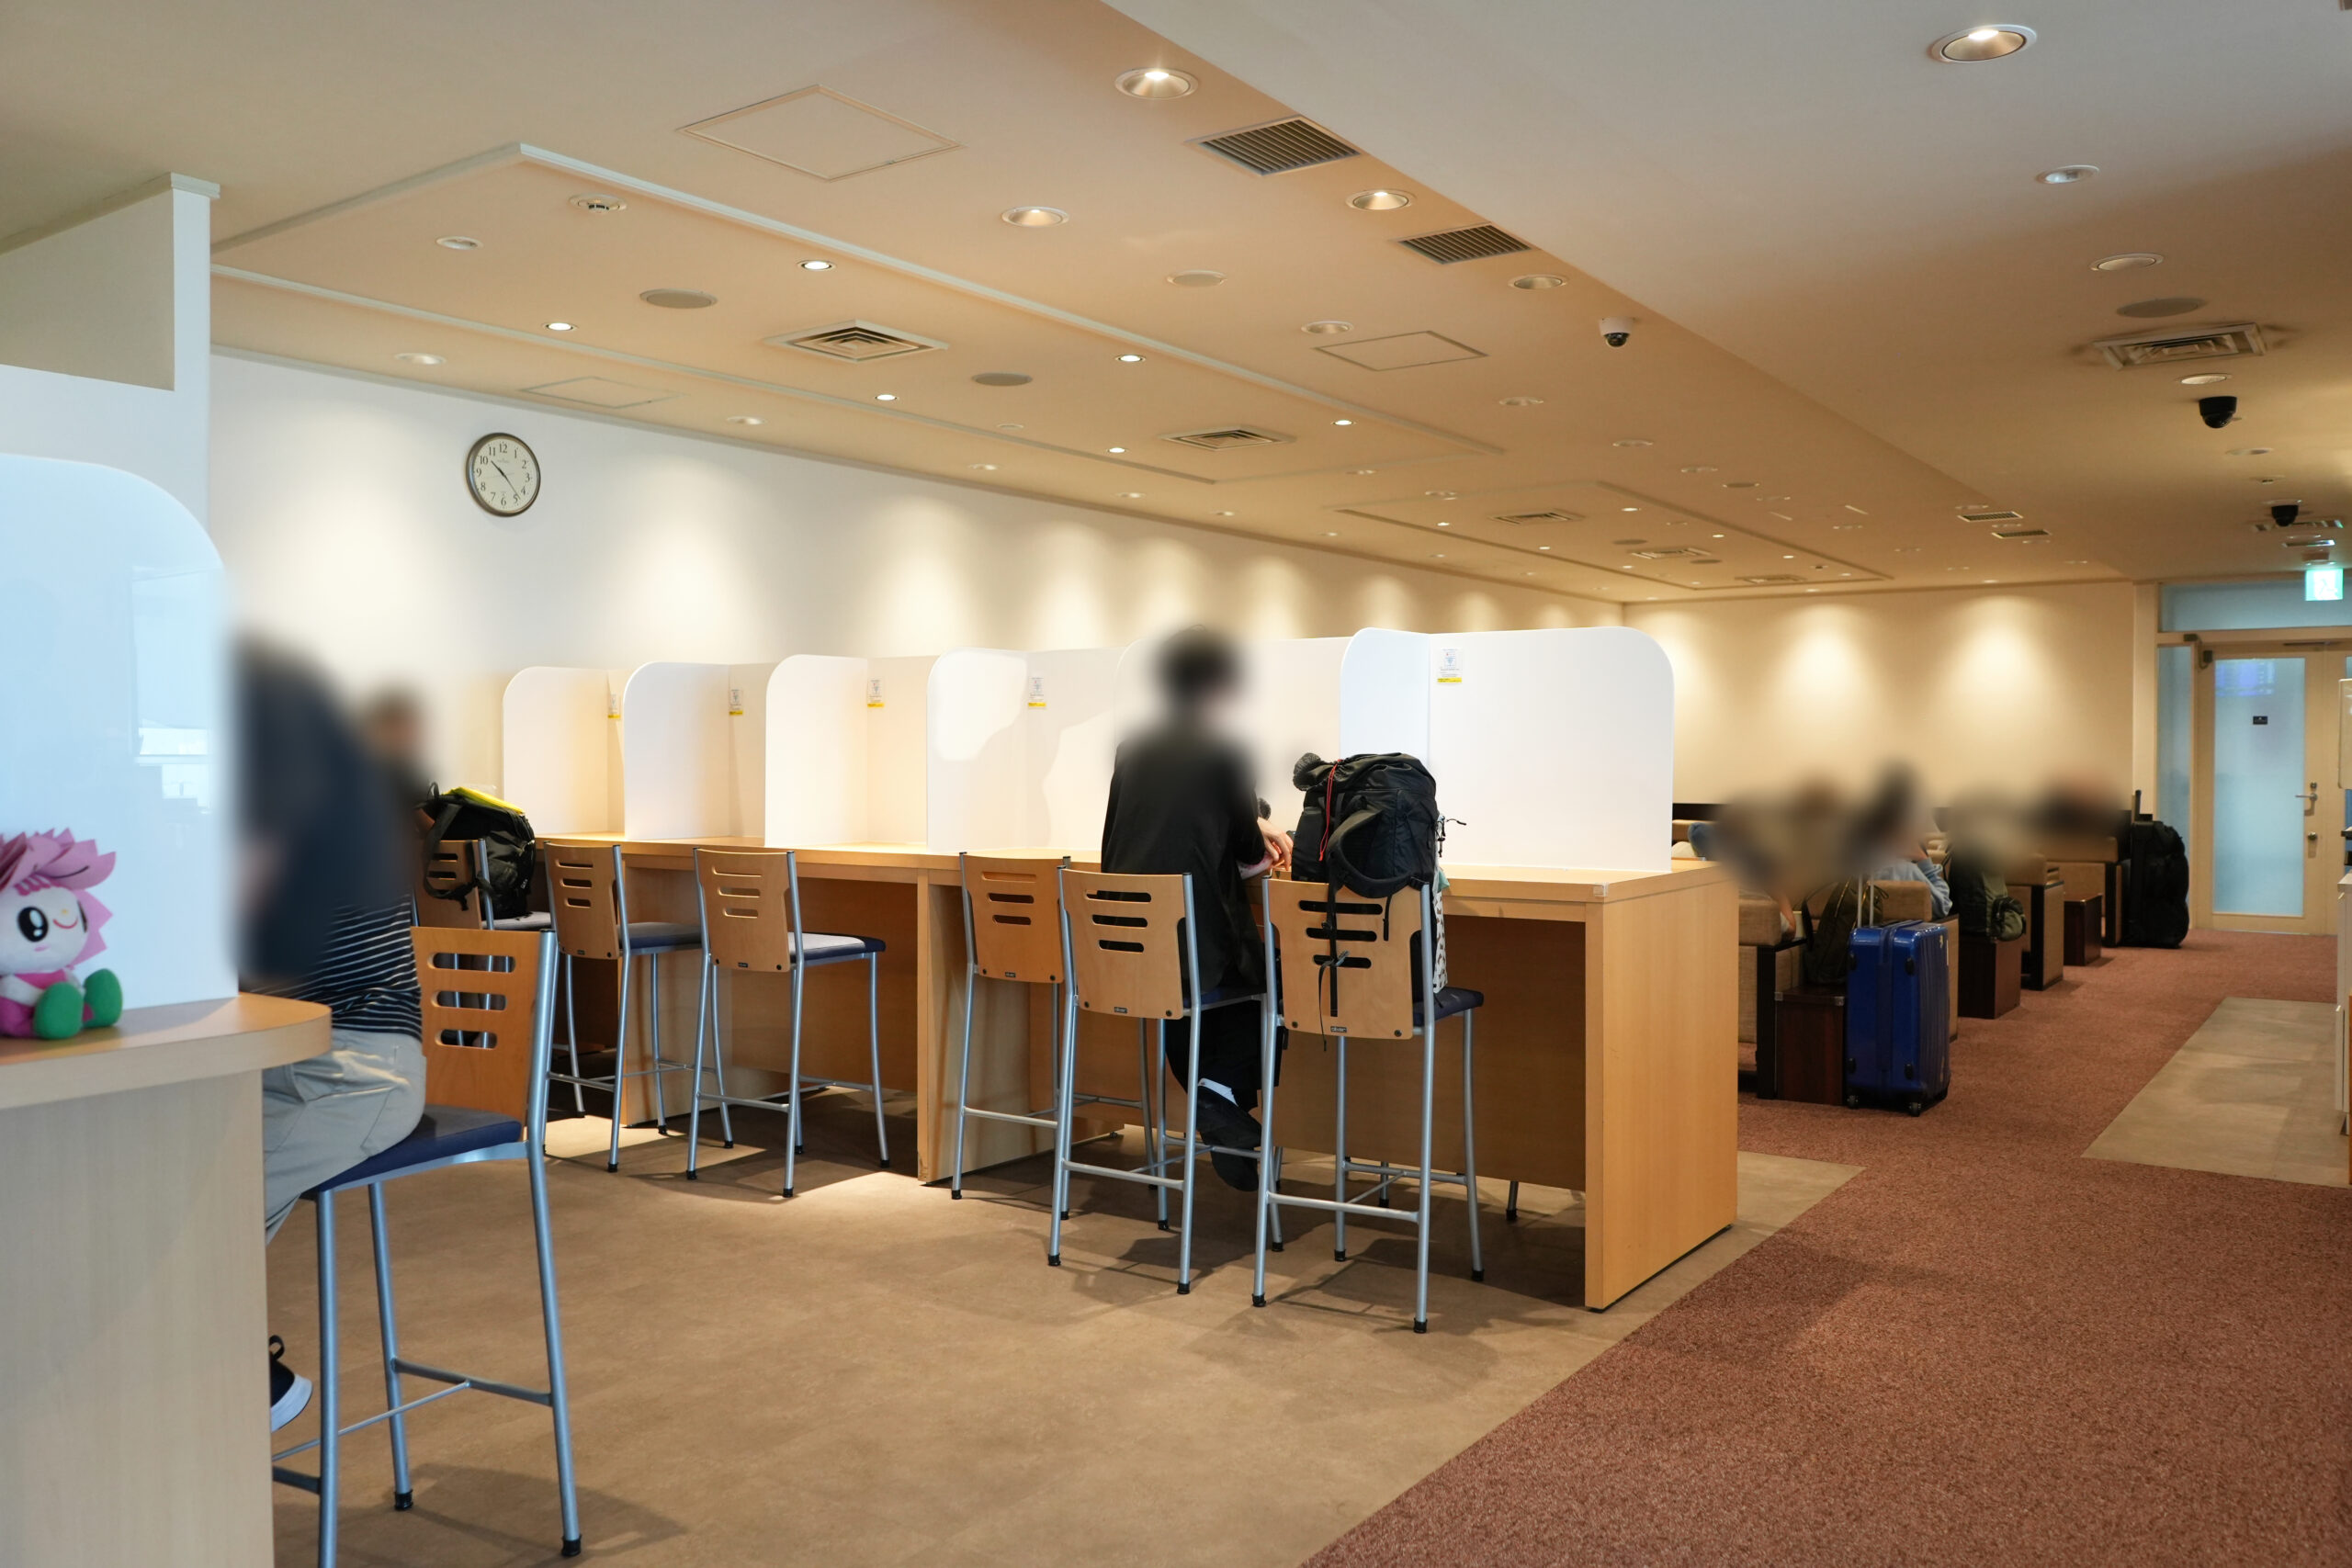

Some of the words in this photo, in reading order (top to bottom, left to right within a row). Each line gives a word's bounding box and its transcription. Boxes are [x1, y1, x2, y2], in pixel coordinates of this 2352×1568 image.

[489, 446, 496, 457] 11
[499, 443, 507, 453] 12
[480, 456, 489, 465] 10
[522, 460, 527, 469] 2
[476, 468, 481, 477] 9
[525, 473, 530, 483] 3
[481, 482, 486, 491] 8
[520, 486, 526, 495] 4
[491, 492, 496, 502] 7
[501, 497, 506, 506] 6
[513, 494, 518, 503] 5
